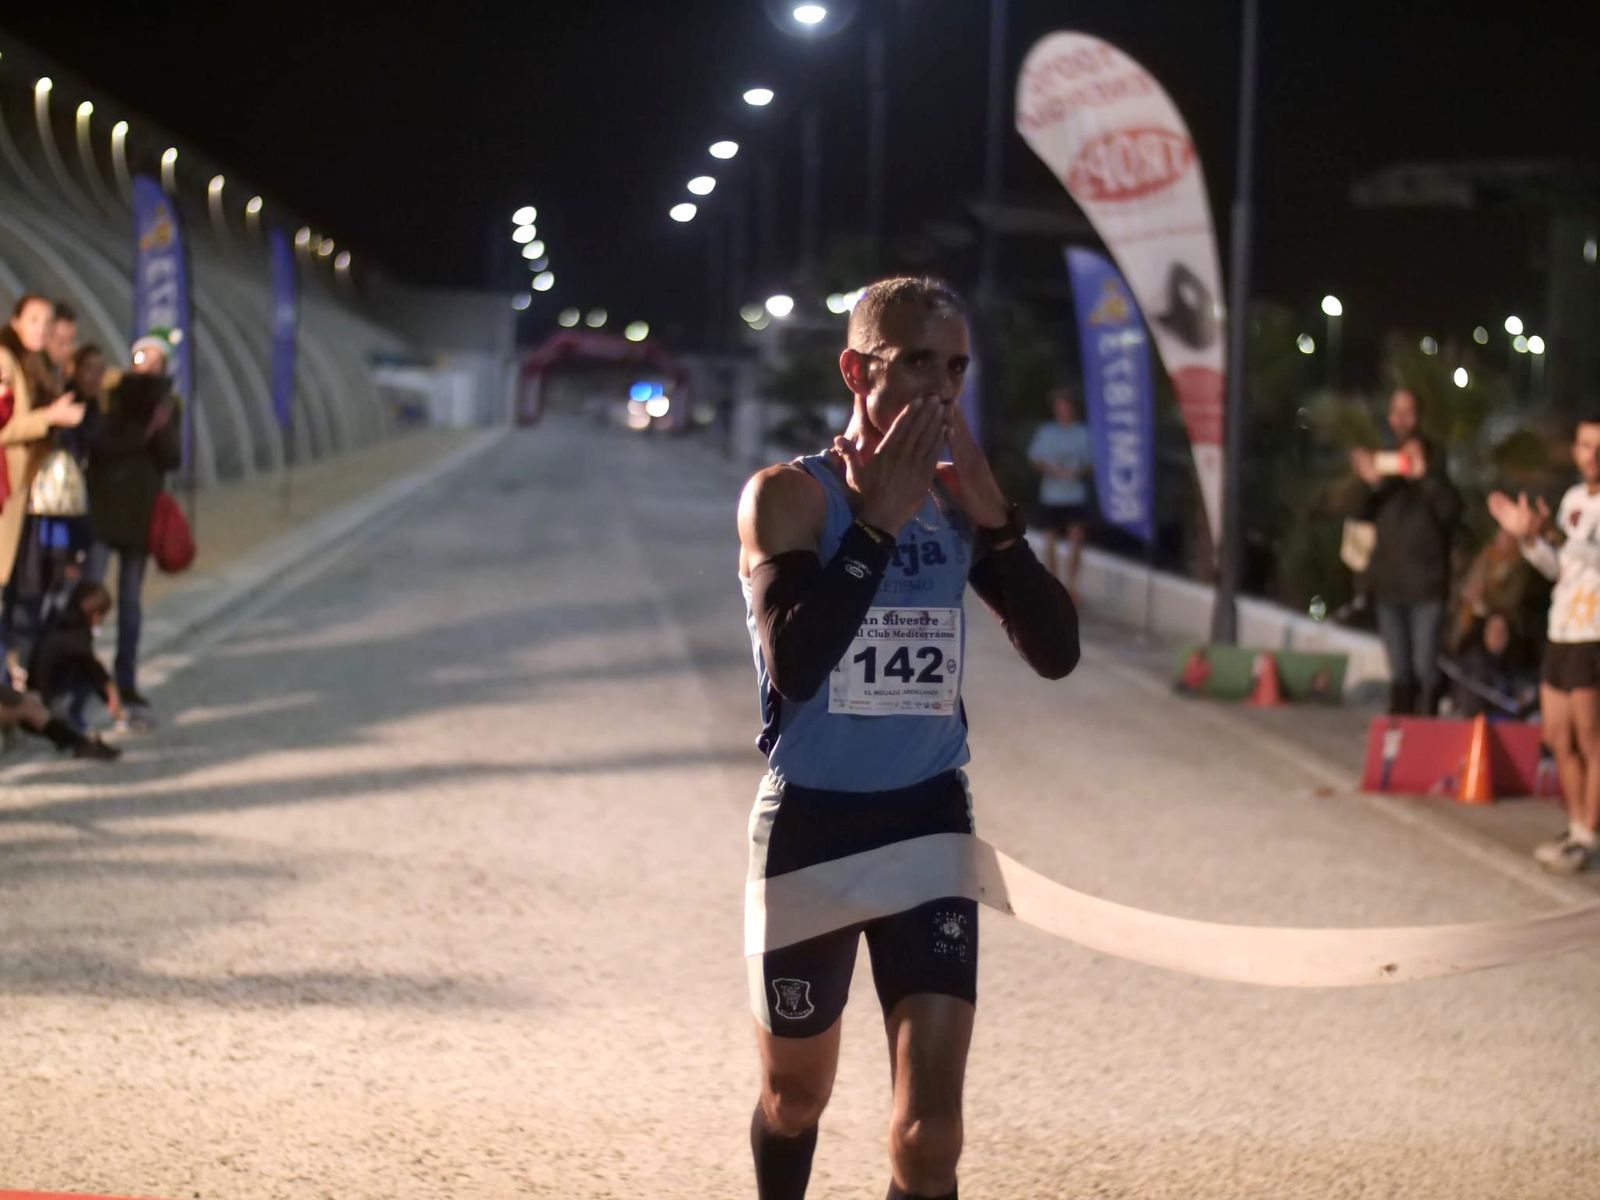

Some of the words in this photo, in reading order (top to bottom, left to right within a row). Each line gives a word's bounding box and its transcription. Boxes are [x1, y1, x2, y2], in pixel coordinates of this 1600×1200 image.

[862, 617, 878, 625] an
[882, 614, 939, 626] Silvestre
[867, 629, 890, 638] Club
[854, 646, 944, 684] 142
